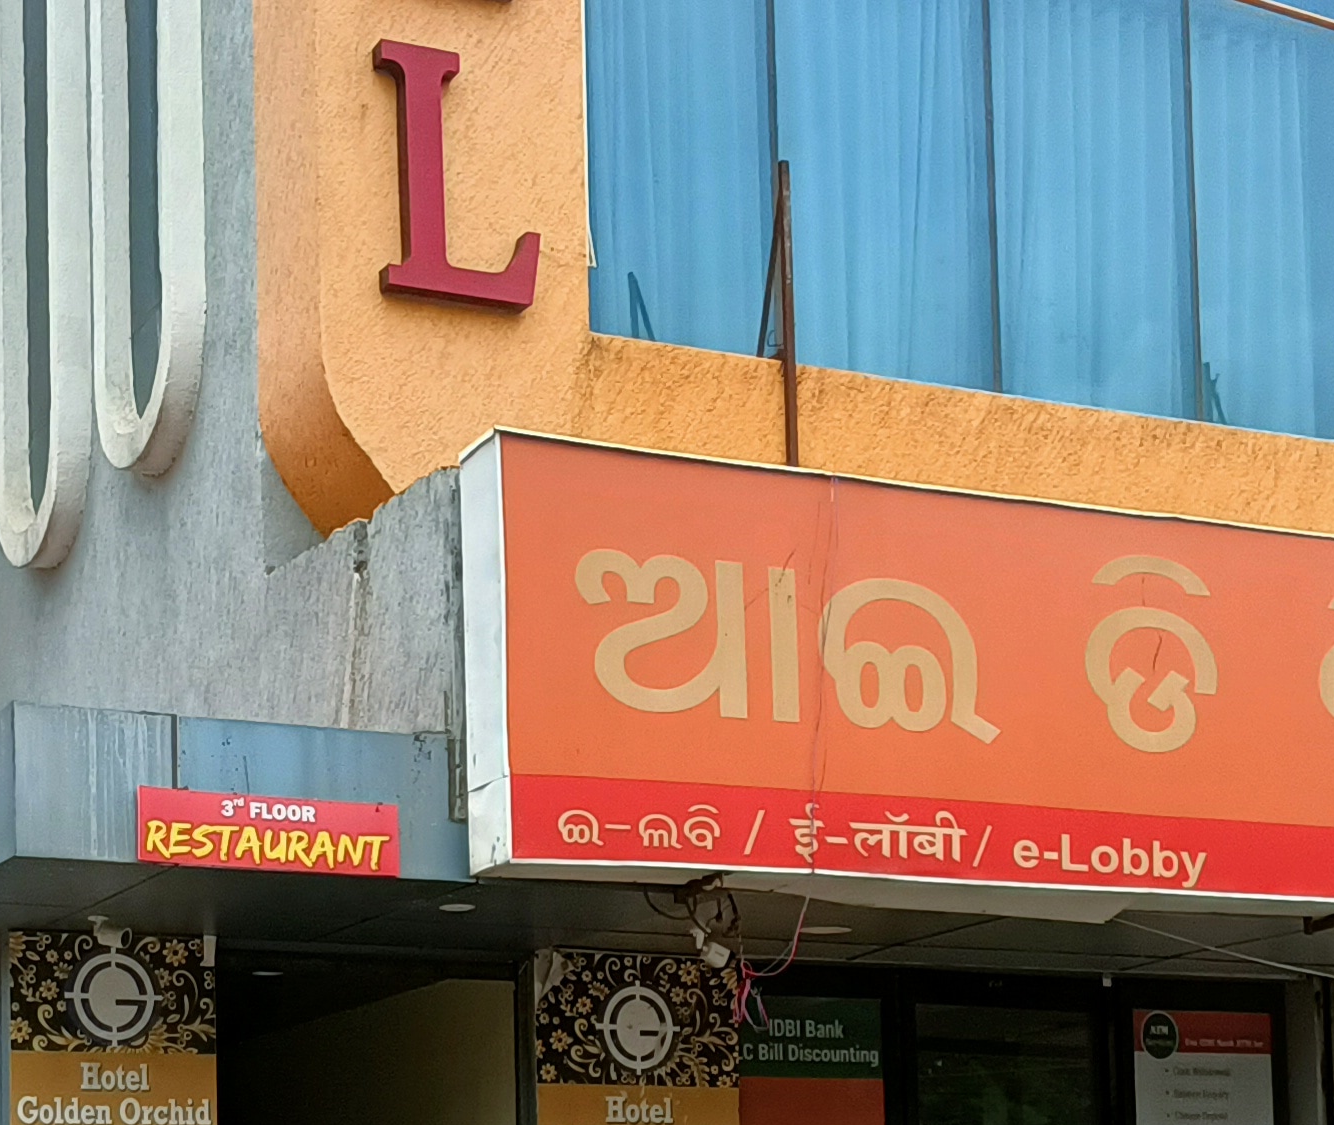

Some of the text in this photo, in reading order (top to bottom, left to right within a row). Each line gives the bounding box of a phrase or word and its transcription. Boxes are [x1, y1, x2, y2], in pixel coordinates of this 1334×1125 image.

[575, 548, 1001, 744] ଆଇ
[220, 796, 316, 823] 3rd FLOOR
[145, 819, 391, 871] RESTAURANT
[1012, 832, 1208, 889] e-Lobby
[769, 1018, 844, 1039] IDBI Bank
[758, 1043, 784, 1061] Bill
[788, 1045, 880, 1067] Discounting
[80, 1061, 150, 1091] Hotel
[17, 1095, 113, 1125] Golden
[605, 1096, 674, 1124] Hotel
